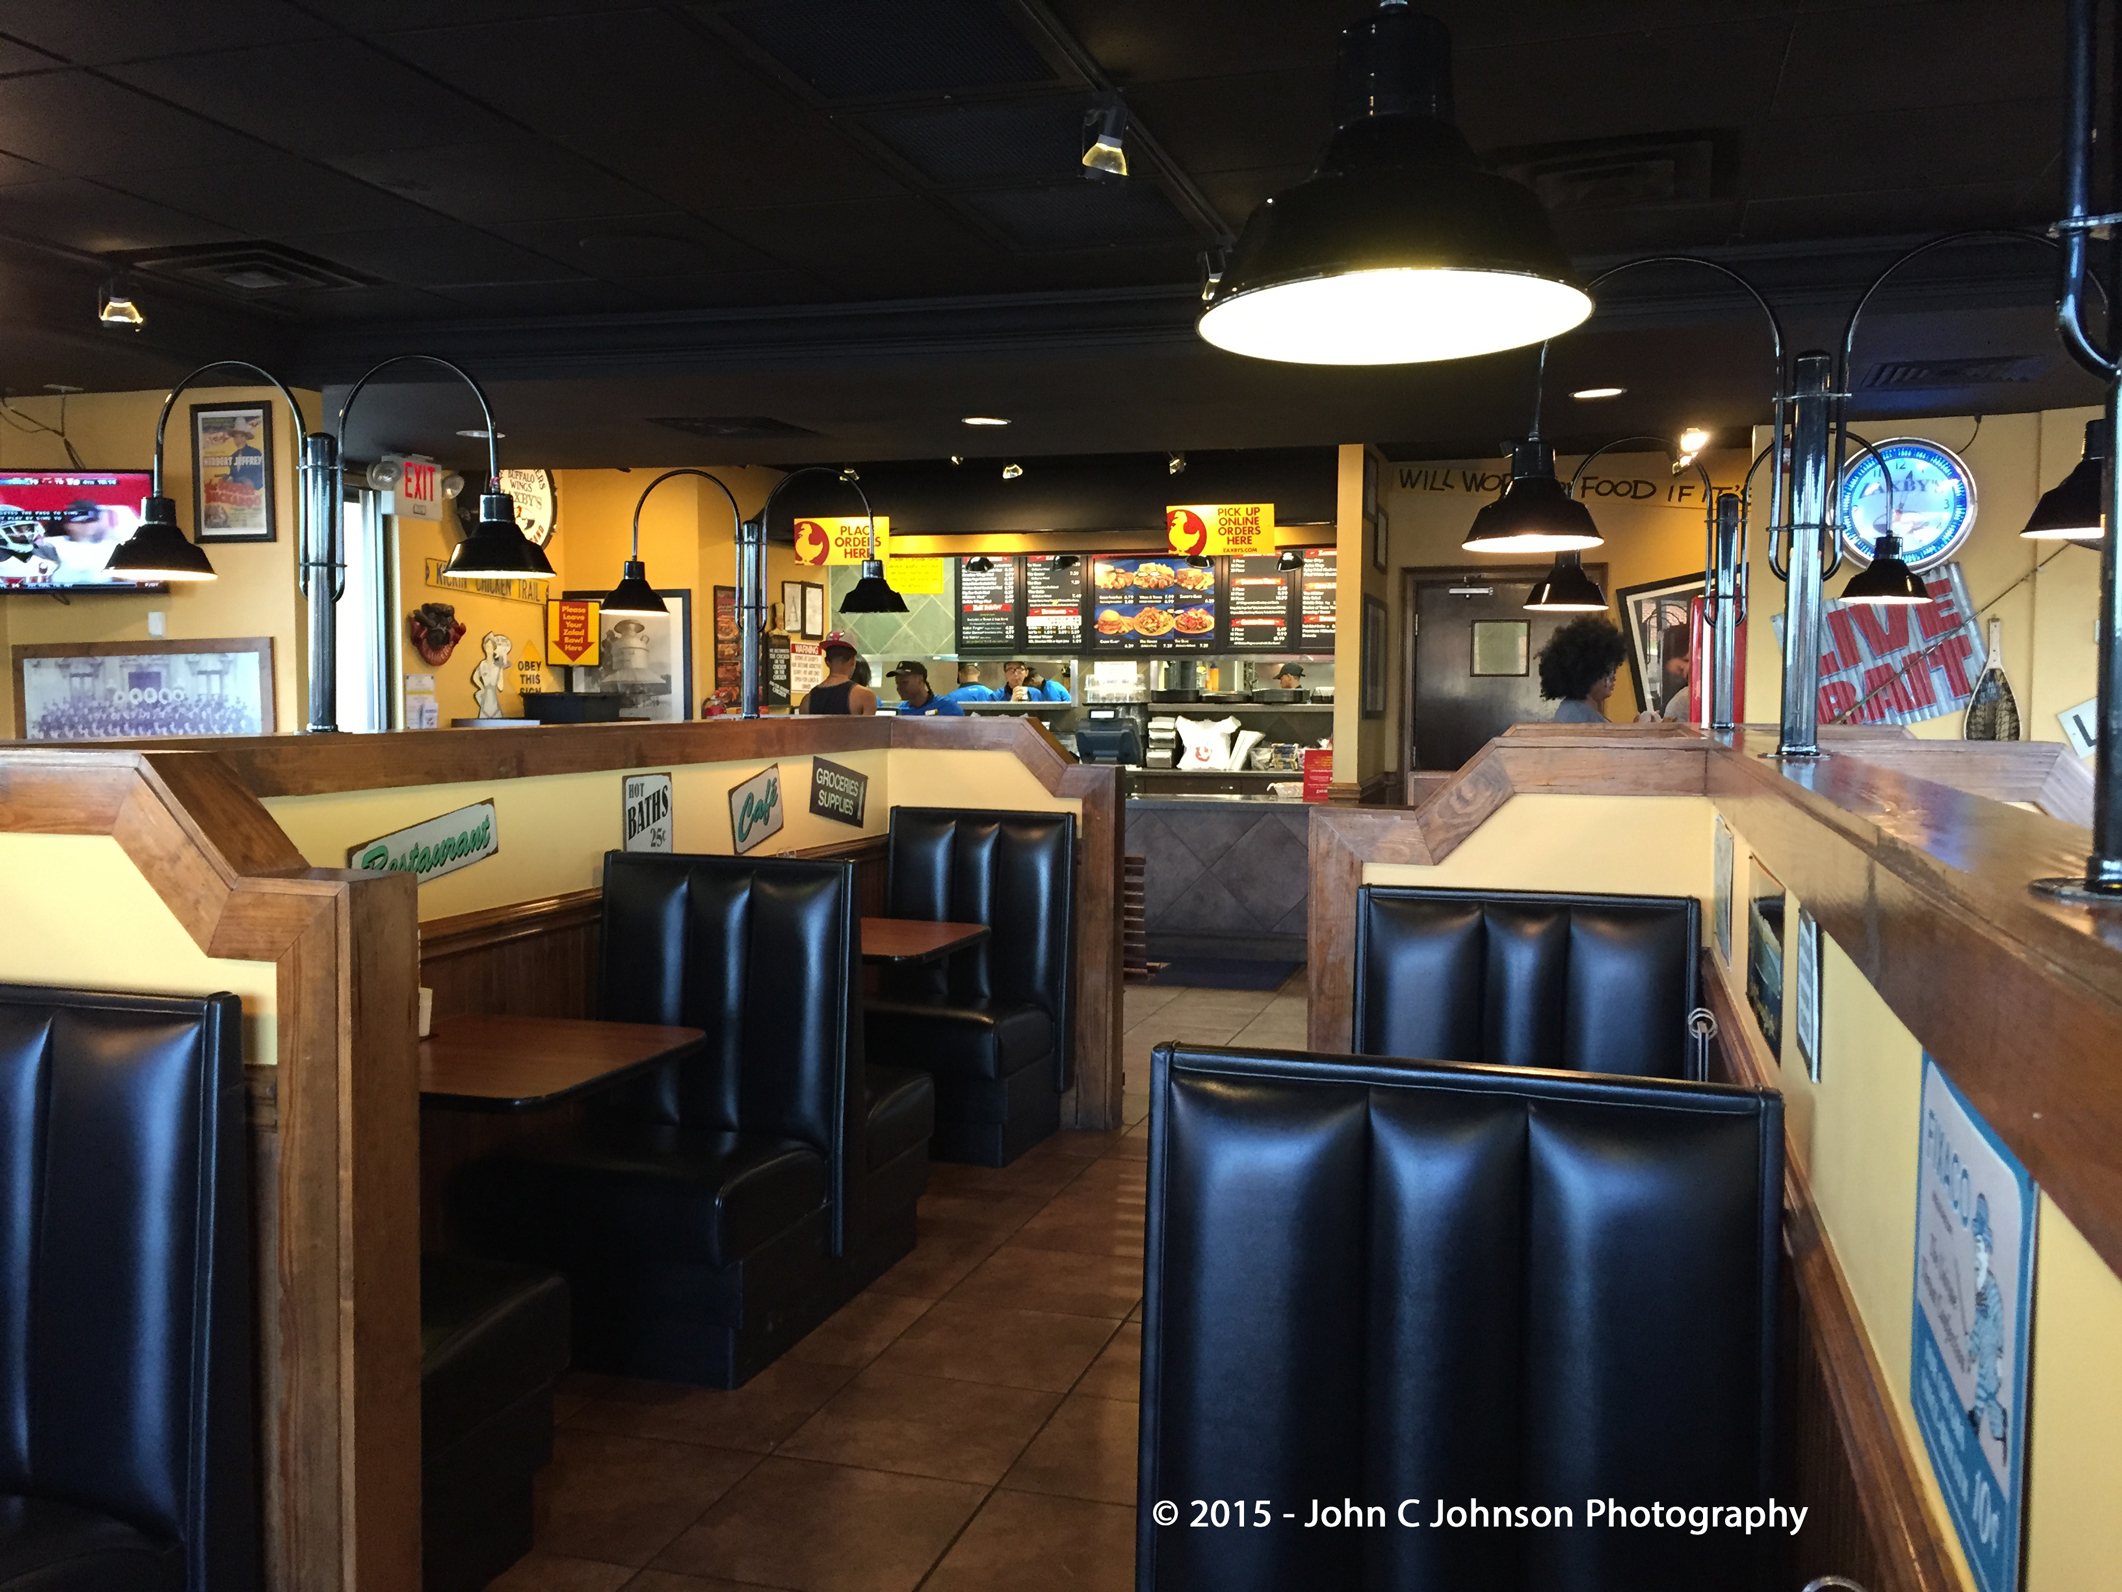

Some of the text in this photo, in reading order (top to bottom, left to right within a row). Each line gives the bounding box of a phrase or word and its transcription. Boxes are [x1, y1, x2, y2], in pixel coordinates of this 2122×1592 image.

[1895, 461, 1906, 470] 12
[404, 461, 436, 501] EXIT
[508, 469, 535, 483] BUFFALO
[510, 479, 533, 492] WINGS
[1399, 468, 1455, 492] WILL
[1462, 471, 1514, 492] WOR
[1581, 476, 1657, 500] FOOD
[1668, 485, 1695, 502] IF
[1702, 484, 1752, 506] IT'S
[1944, 498, 1950, 510] 3
[1218, 507, 1260, 516] PICK UP
[1218, 517, 1259, 526] ONLINE
[840, 526, 873, 536] PLAC
[1218, 526, 1261, 536] ORDERS
[1226, 536, 1252, 545] HERE
[475, 578, 512, 597] CHICKEN
[517, 579, 540, 601] TRAIL
[794, 644, 819, 655] WARNING
[518, 661, 542, 671] OBEY
[520, 674, 541, 684] THIS
[1818, 634, 1973, 725] BAIT
[816, 767, 858, 797] GROCERIES
[628, 782, 644, 798] HOT
[818, 790, 854, 816] SUPPLIES
[628, 784, 669, 841] BATHS
[361, 814, 491, 874] Restaurant
